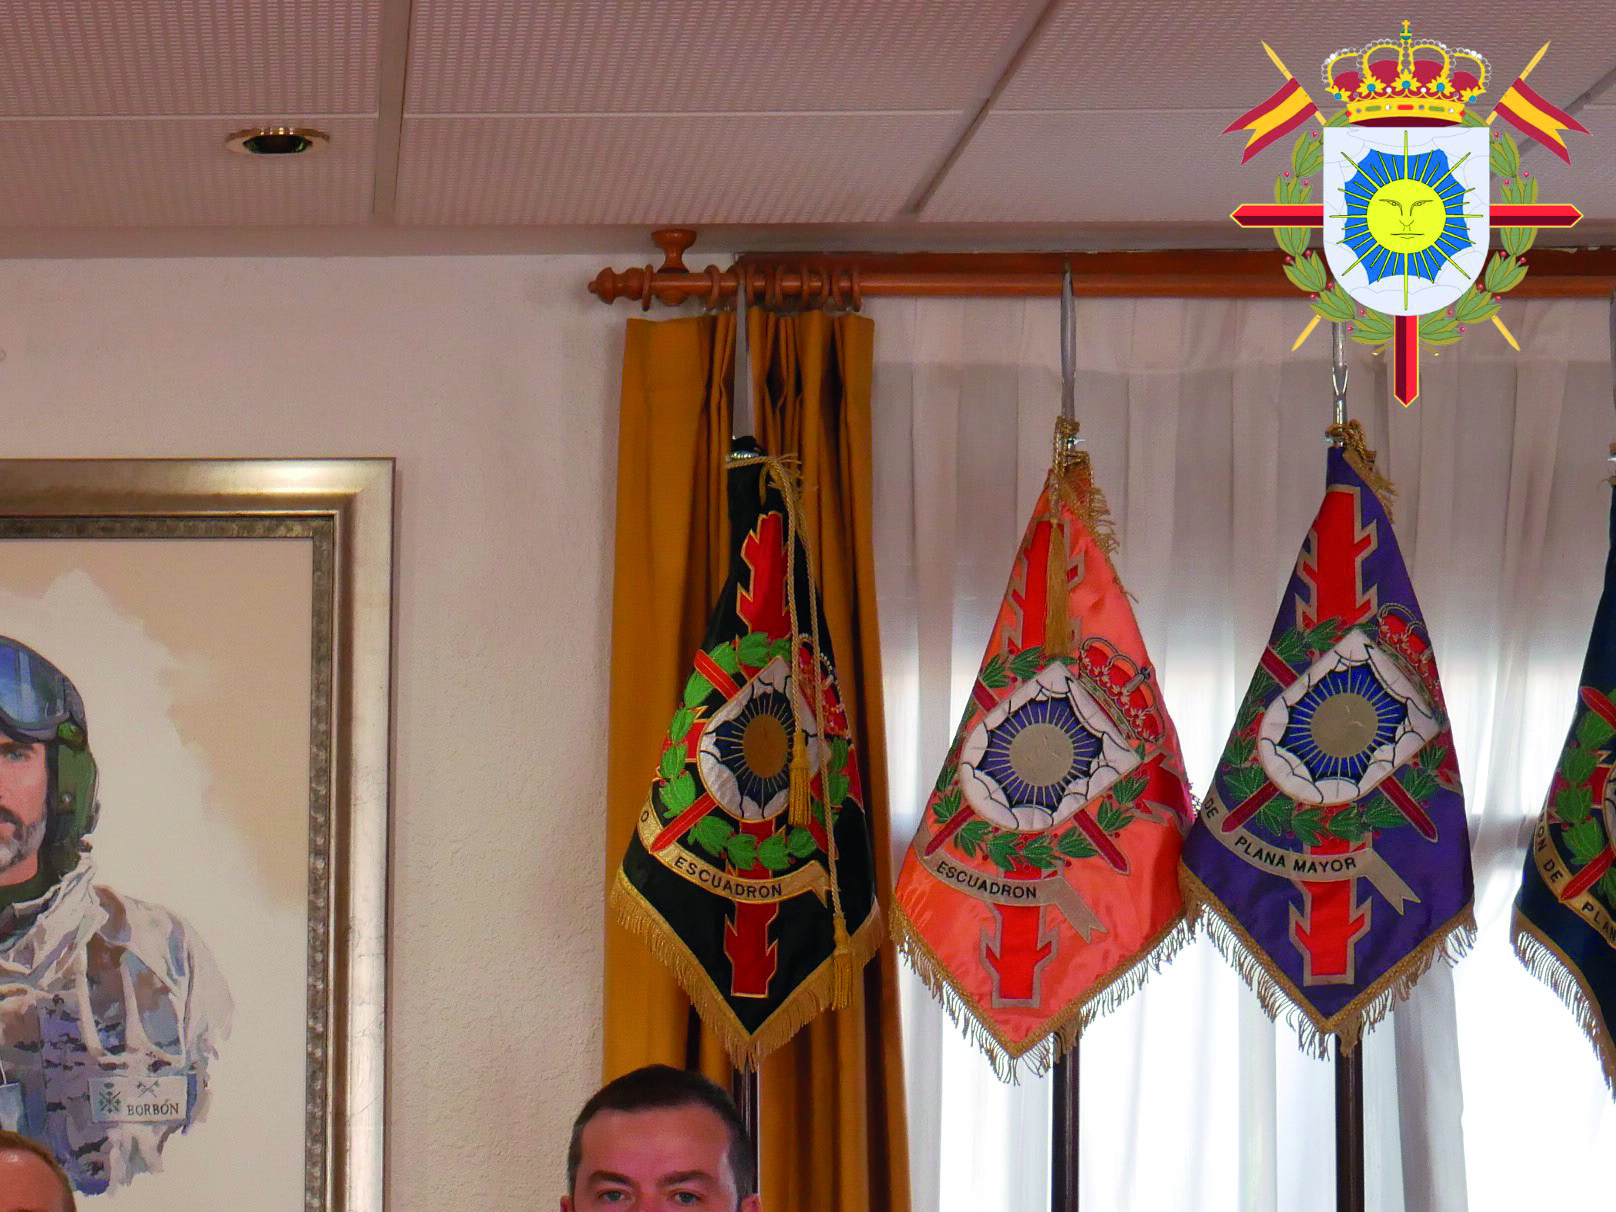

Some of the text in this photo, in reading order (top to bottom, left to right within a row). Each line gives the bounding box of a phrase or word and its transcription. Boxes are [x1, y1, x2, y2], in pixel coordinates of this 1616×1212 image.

[1204, 798, 1356, 874] DE PLANA MAYOR
[674, 856, 782, 899] ESCUADRON
[936, 860, 1037, 899] ESCUADRON
[1544, 859, 1563, 883] DE
[126, 1099, 180, 1117] BORBÓN
